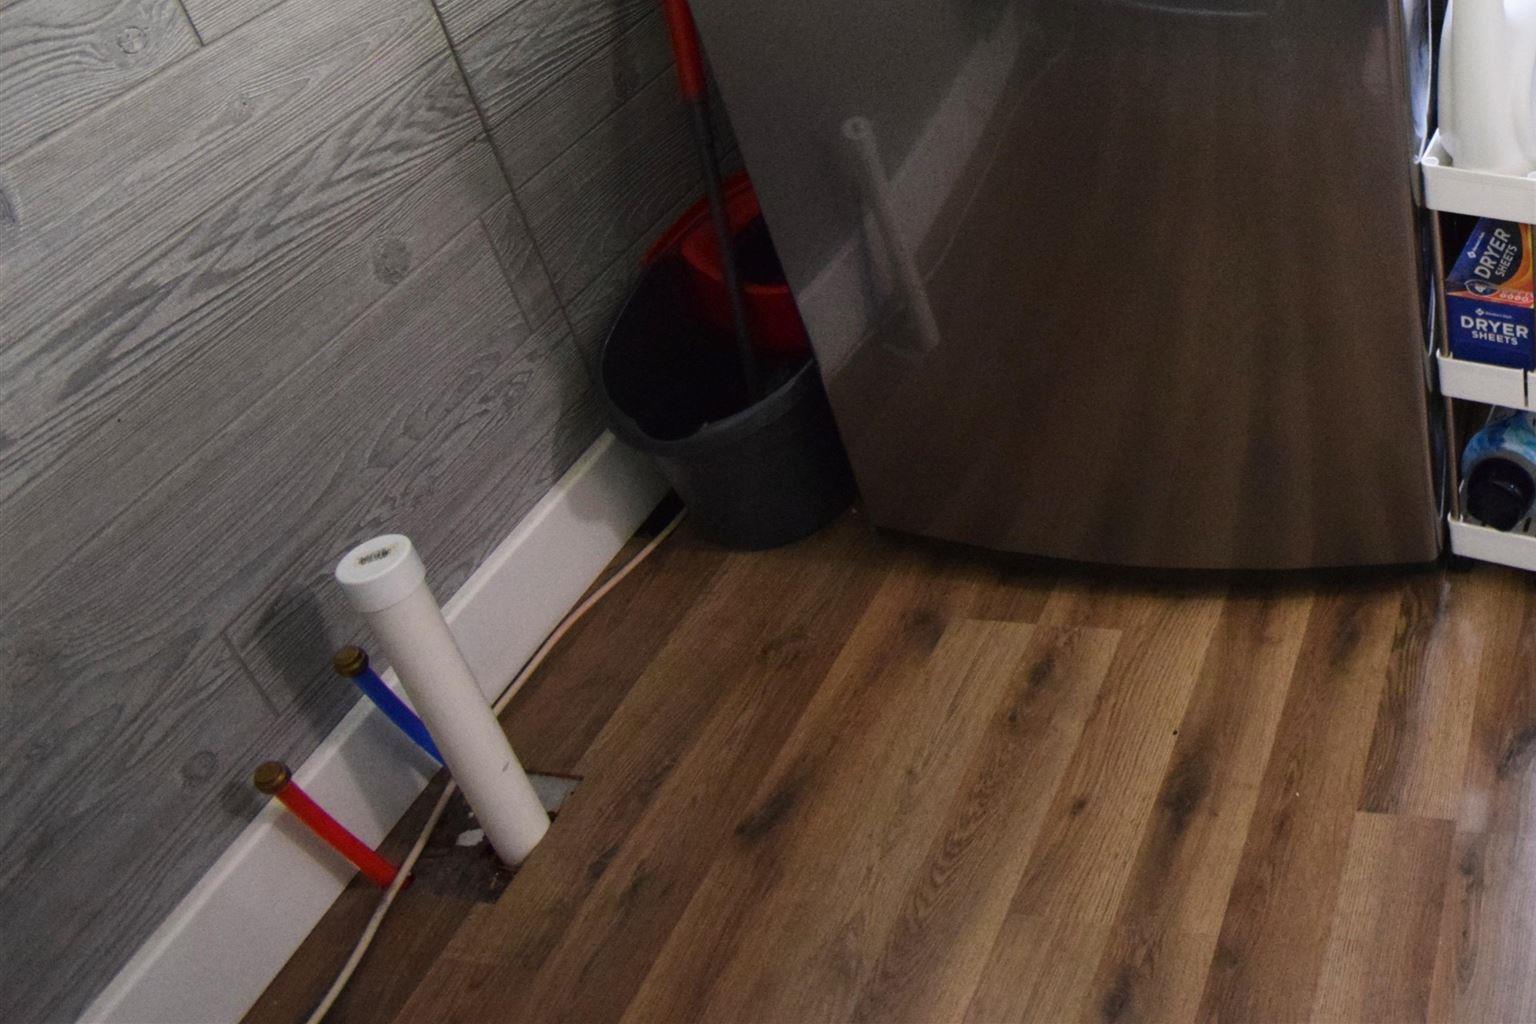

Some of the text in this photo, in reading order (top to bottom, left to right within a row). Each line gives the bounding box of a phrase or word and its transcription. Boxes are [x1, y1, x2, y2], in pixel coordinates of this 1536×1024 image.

[1473, 228, 1511, 279] DRYER
[1494, 244, 1518, 277] SHEETS
[1460, 315, 1529, 339] DRYER
[1471, 329, 1519, 346] SHEETS
